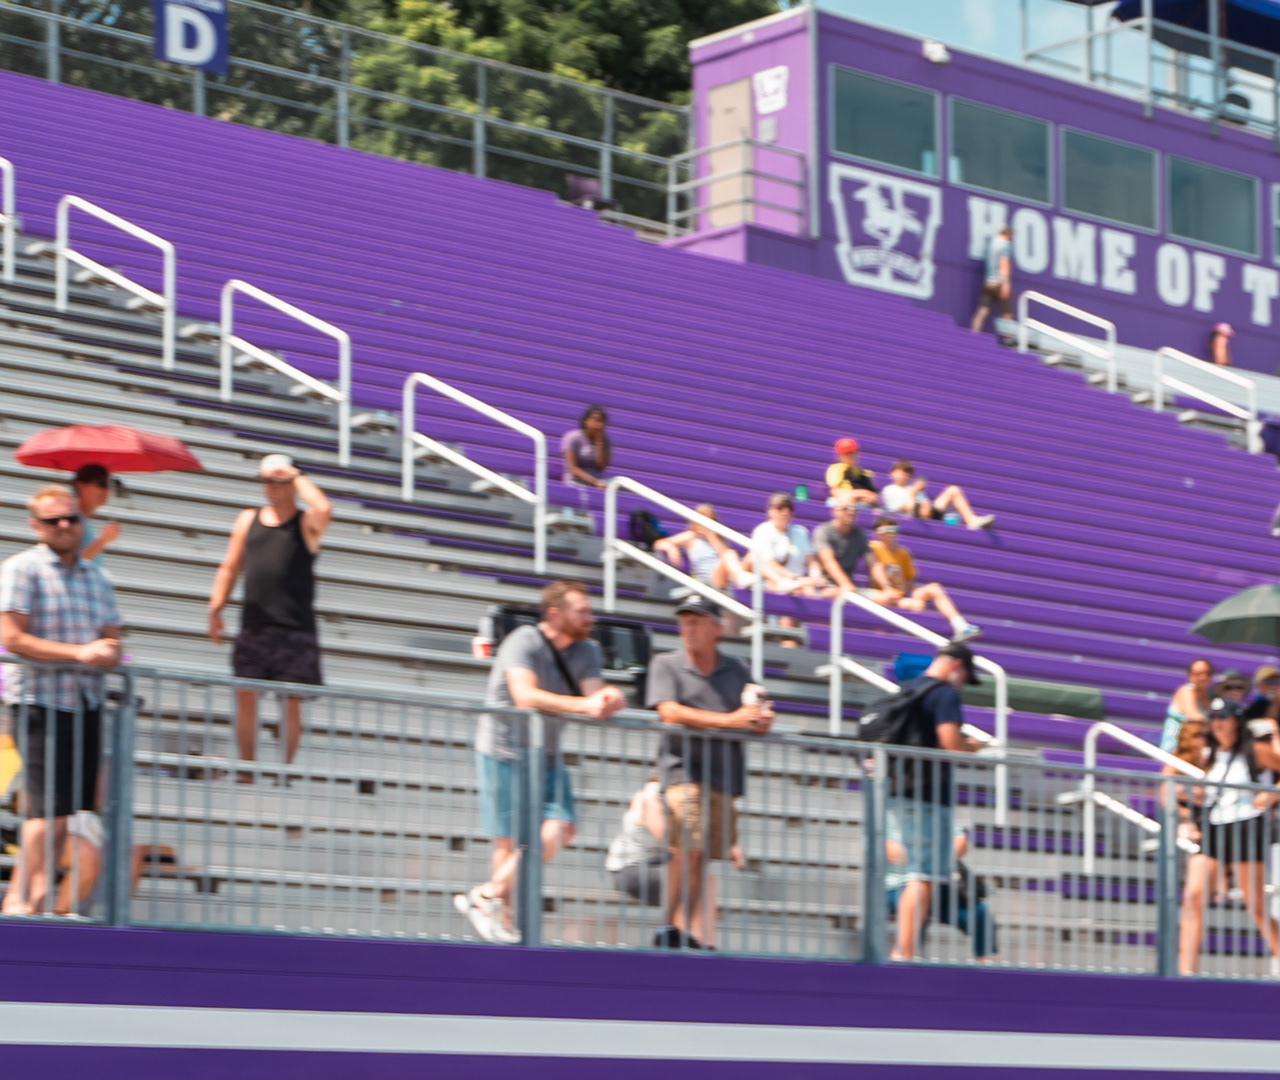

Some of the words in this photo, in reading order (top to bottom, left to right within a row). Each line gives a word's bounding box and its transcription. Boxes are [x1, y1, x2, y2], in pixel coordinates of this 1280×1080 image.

[165, 2, 218, 66] D
[968, 196, 1138, 295] HOME
[1156, 243, 1226, 313] OF
